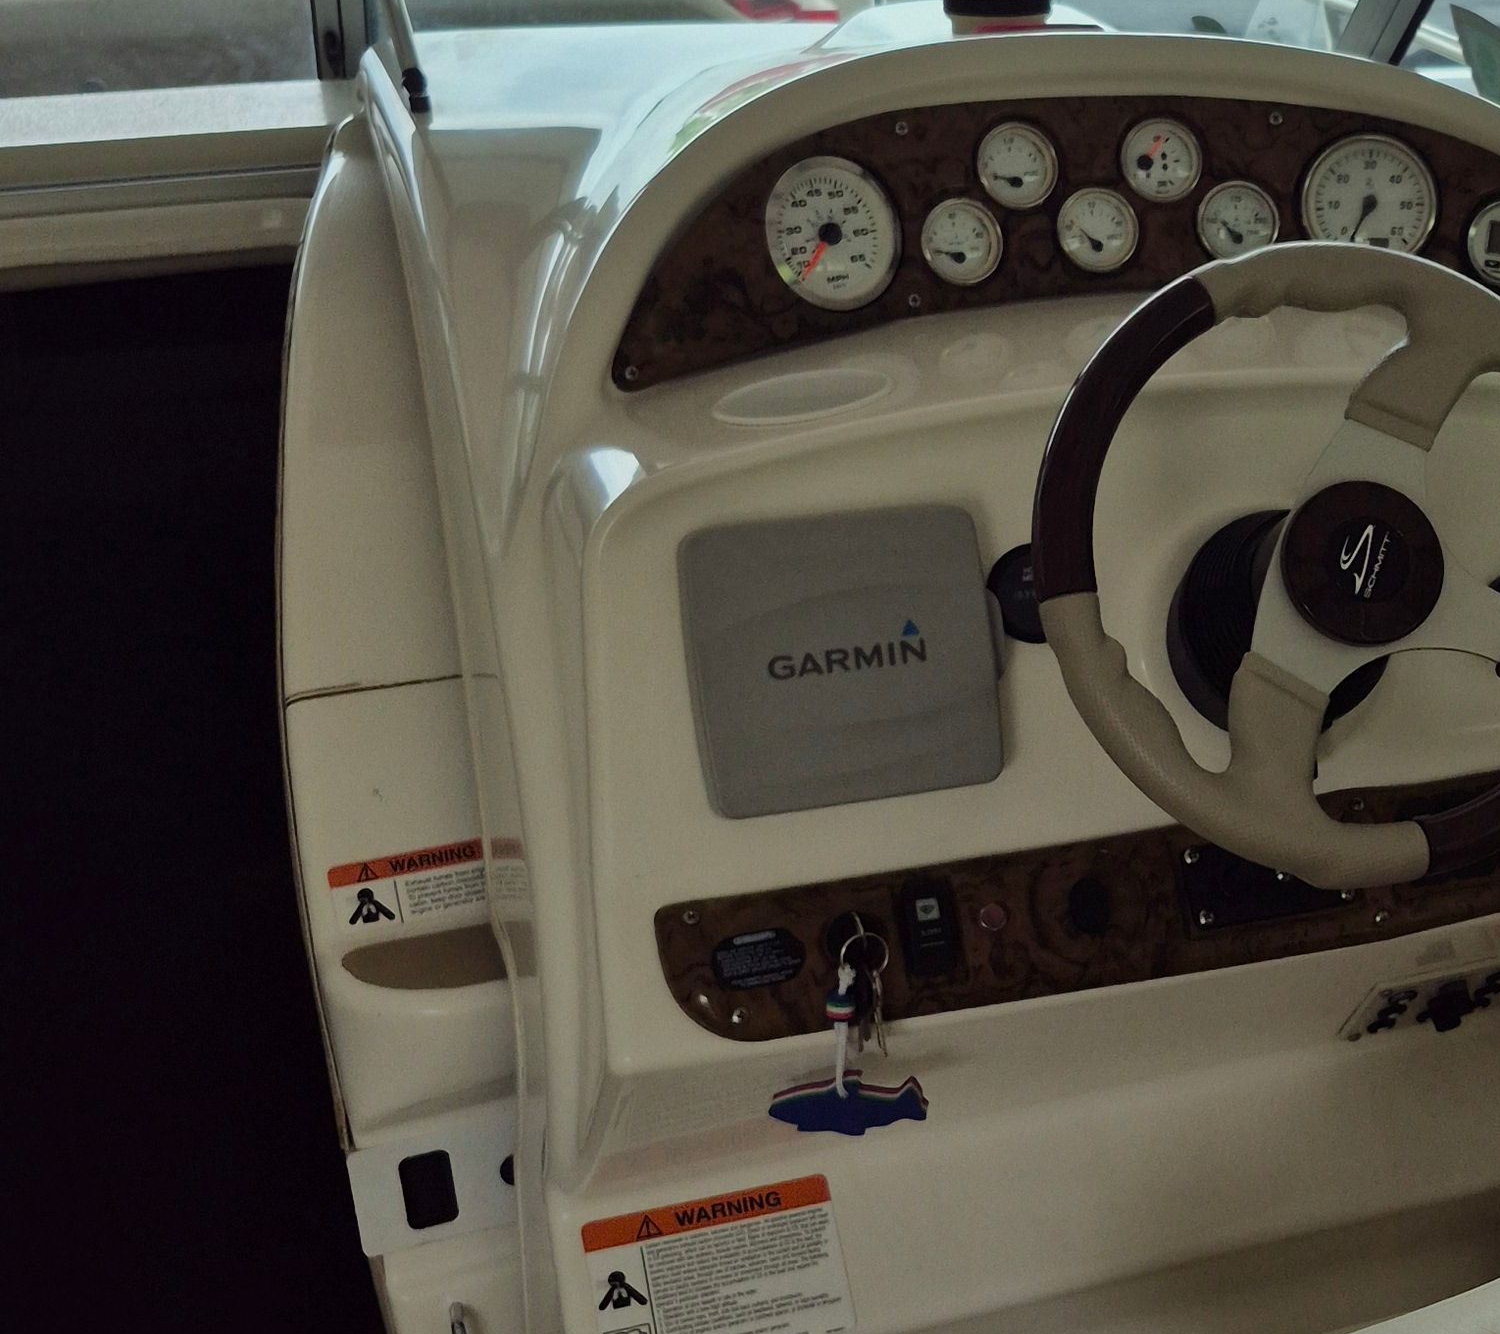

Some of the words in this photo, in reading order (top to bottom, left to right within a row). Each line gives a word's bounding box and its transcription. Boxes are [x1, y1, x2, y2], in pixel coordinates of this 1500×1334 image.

[1364, 160, 1377, 169] 30
[1336, 174, 1350, 184] 20
[1389, 175, 1402, 184] 40
[807, 189, 822, 197] 45
[827, 190, 844, 199] 50
[791, 199, 807, 208] 40
[1328, 200, 1341, 210] 10
[1400, 201, 1413, 210] 50
[786, 226, 802, 235] 30
[1341, 226, 1348, 235] 0
[1390, 226, 1404, 236] 60
[791, 247, 807, 255] 20
[827, 273, 850, 284] MPH
[1363, 530, 1391, 599] SCHMITT
[767, 636, 928, 681] GARMIN
[389, 846, 475, 873] WARNING
[675, 1191, 782, 1227] WARNING
